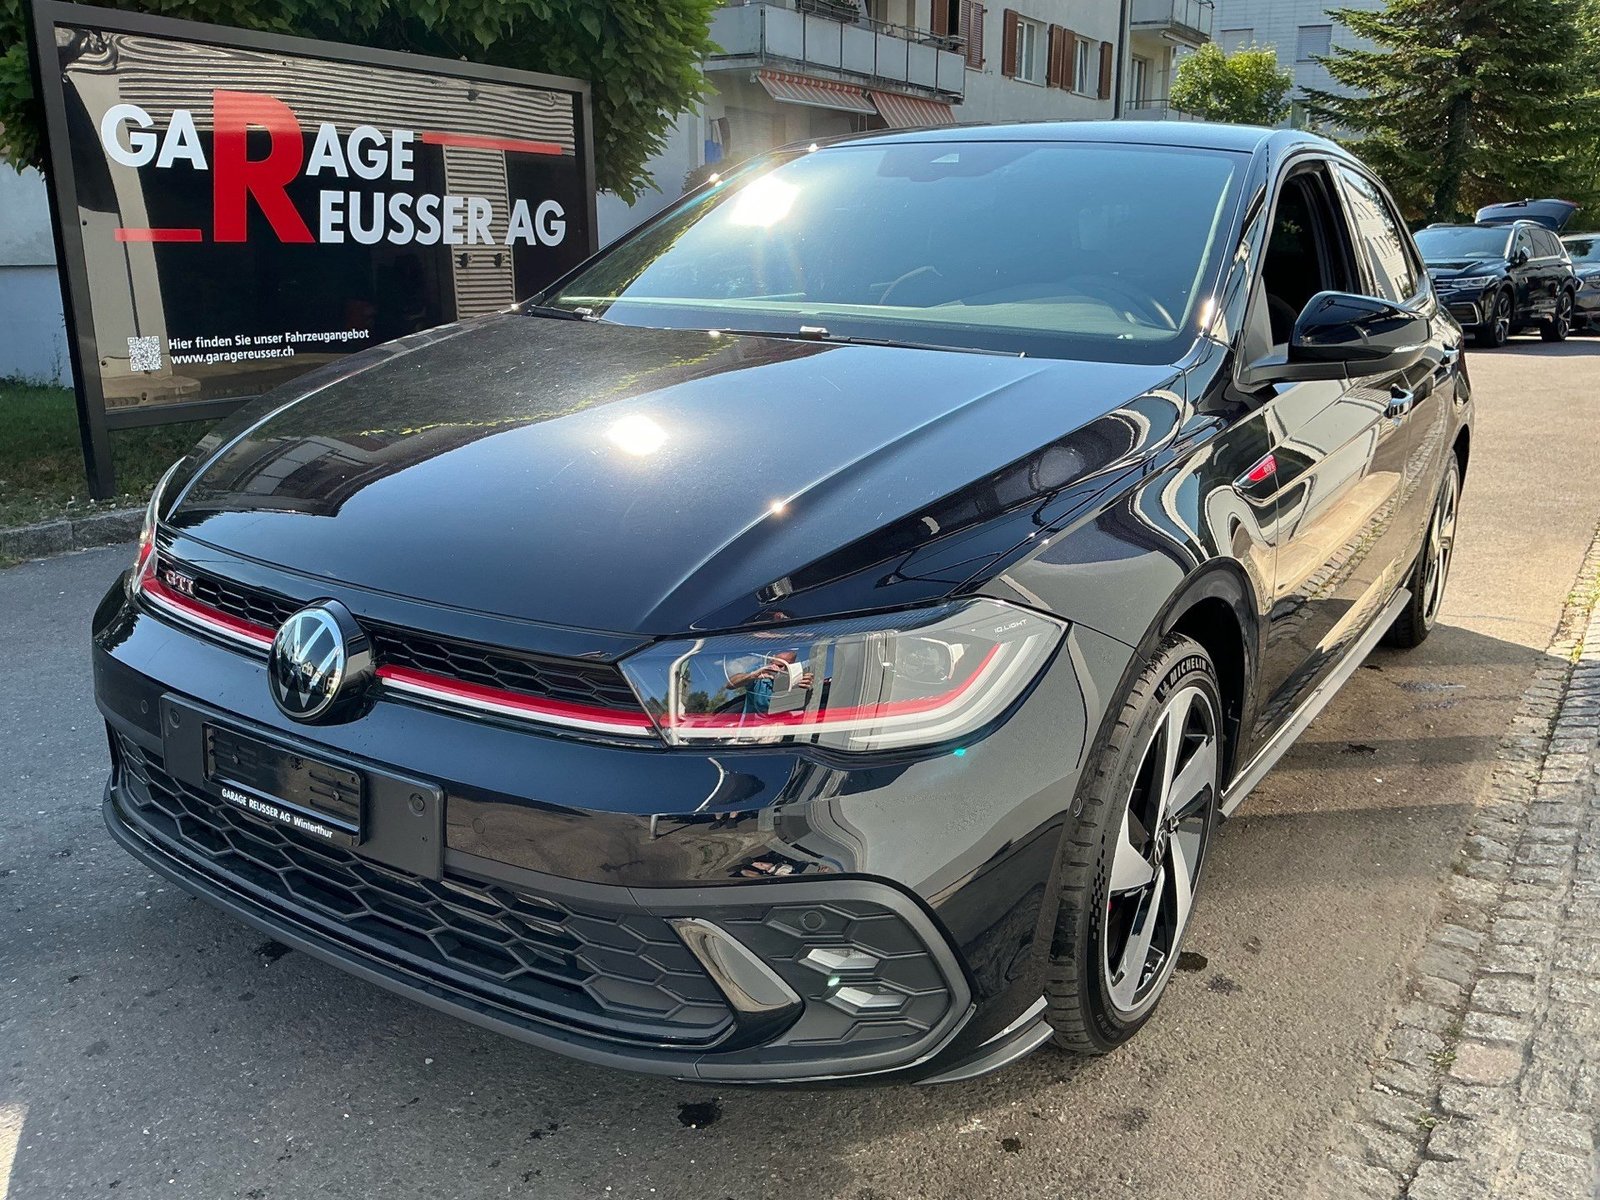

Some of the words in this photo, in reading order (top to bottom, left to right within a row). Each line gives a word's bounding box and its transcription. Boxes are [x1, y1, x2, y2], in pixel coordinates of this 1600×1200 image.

[504, 200, 567, 247] AG
[168, 336, 192, 350] Hier
[195, 333, 231, 348] finden
[234, 332, 251, 346] Sie
[254, 333, 283, 345] unser
[285, 328, 370, 344] Fahrzeugangebot
[170, 345, 295, 365] www.garagereusser.ch
[1169, 657, 1207, 686] MICHELIN
[221, 788, 247, 806] GARAGE
[248, 798, 278, 818] REUSSER
[279, 811, 291, 823] AG
[293, 816, 333, 839] Winterthur
